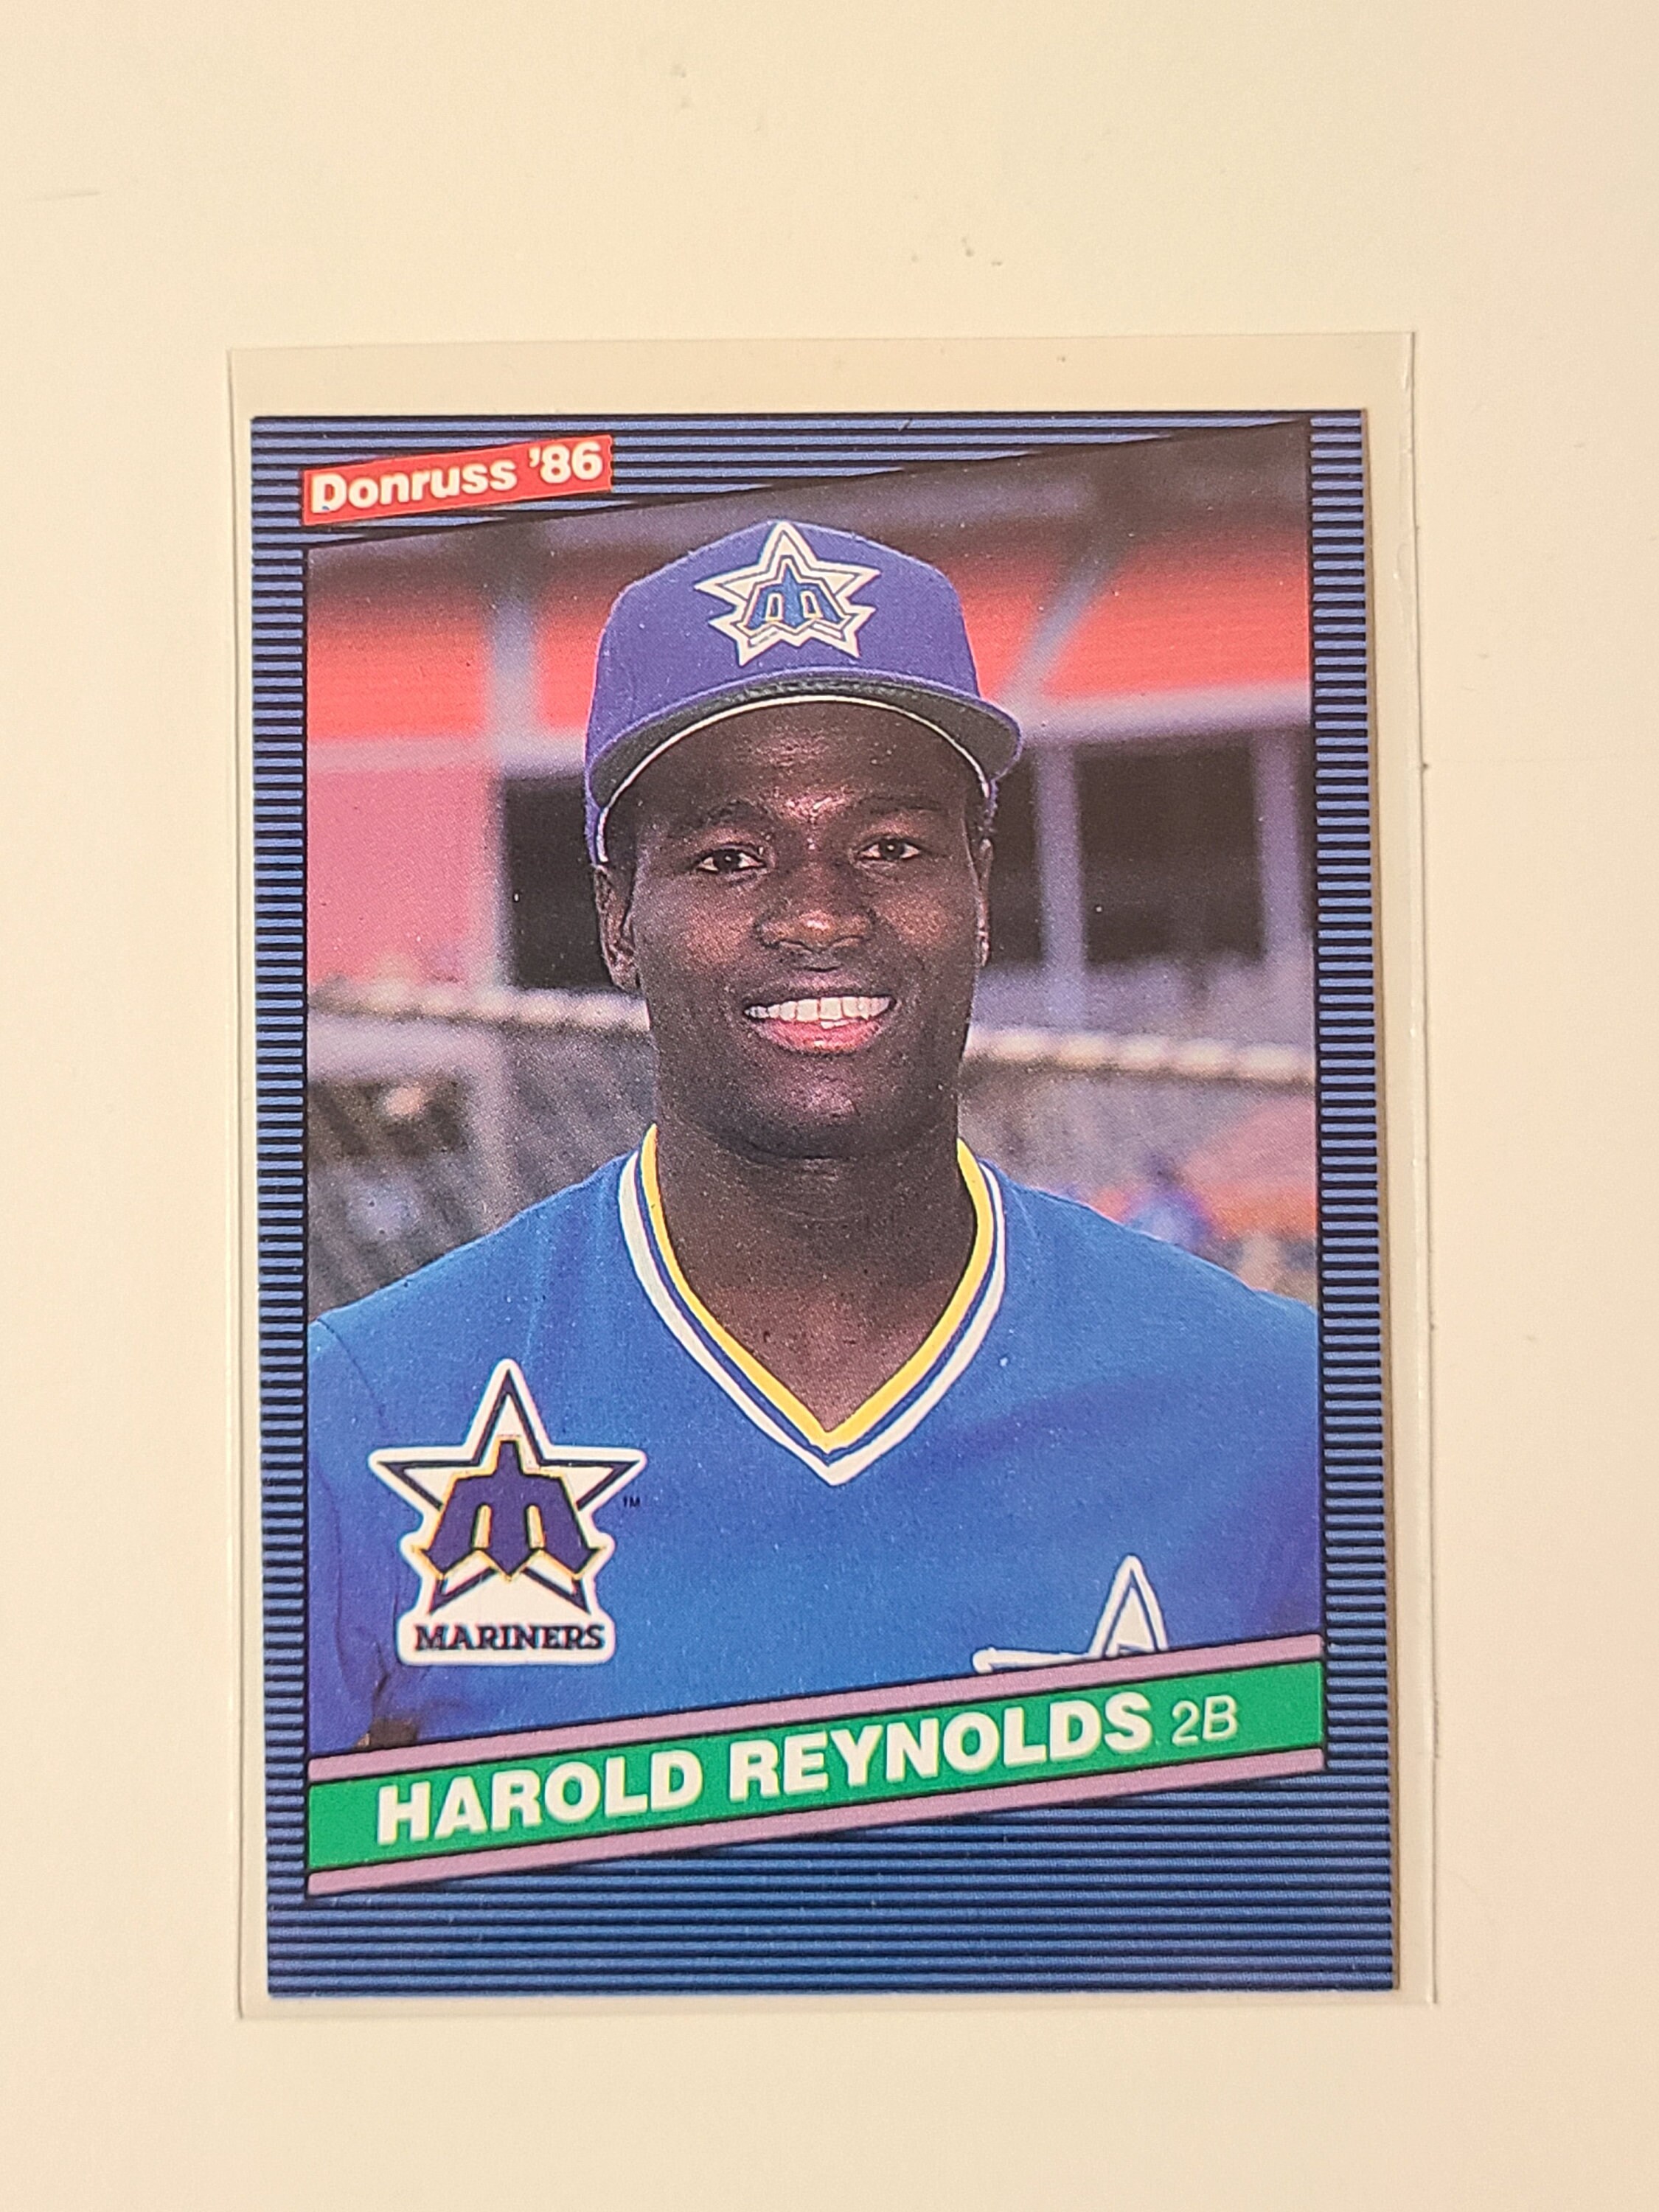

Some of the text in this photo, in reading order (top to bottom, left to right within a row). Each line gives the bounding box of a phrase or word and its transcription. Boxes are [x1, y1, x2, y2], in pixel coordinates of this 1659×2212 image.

[311, 441, 604, 514] Donruss '86
[414, 1624, 605, 1651] MARINERS
[377, 1691, 1238, 1846] HAROLD REYNOLDS 2B
